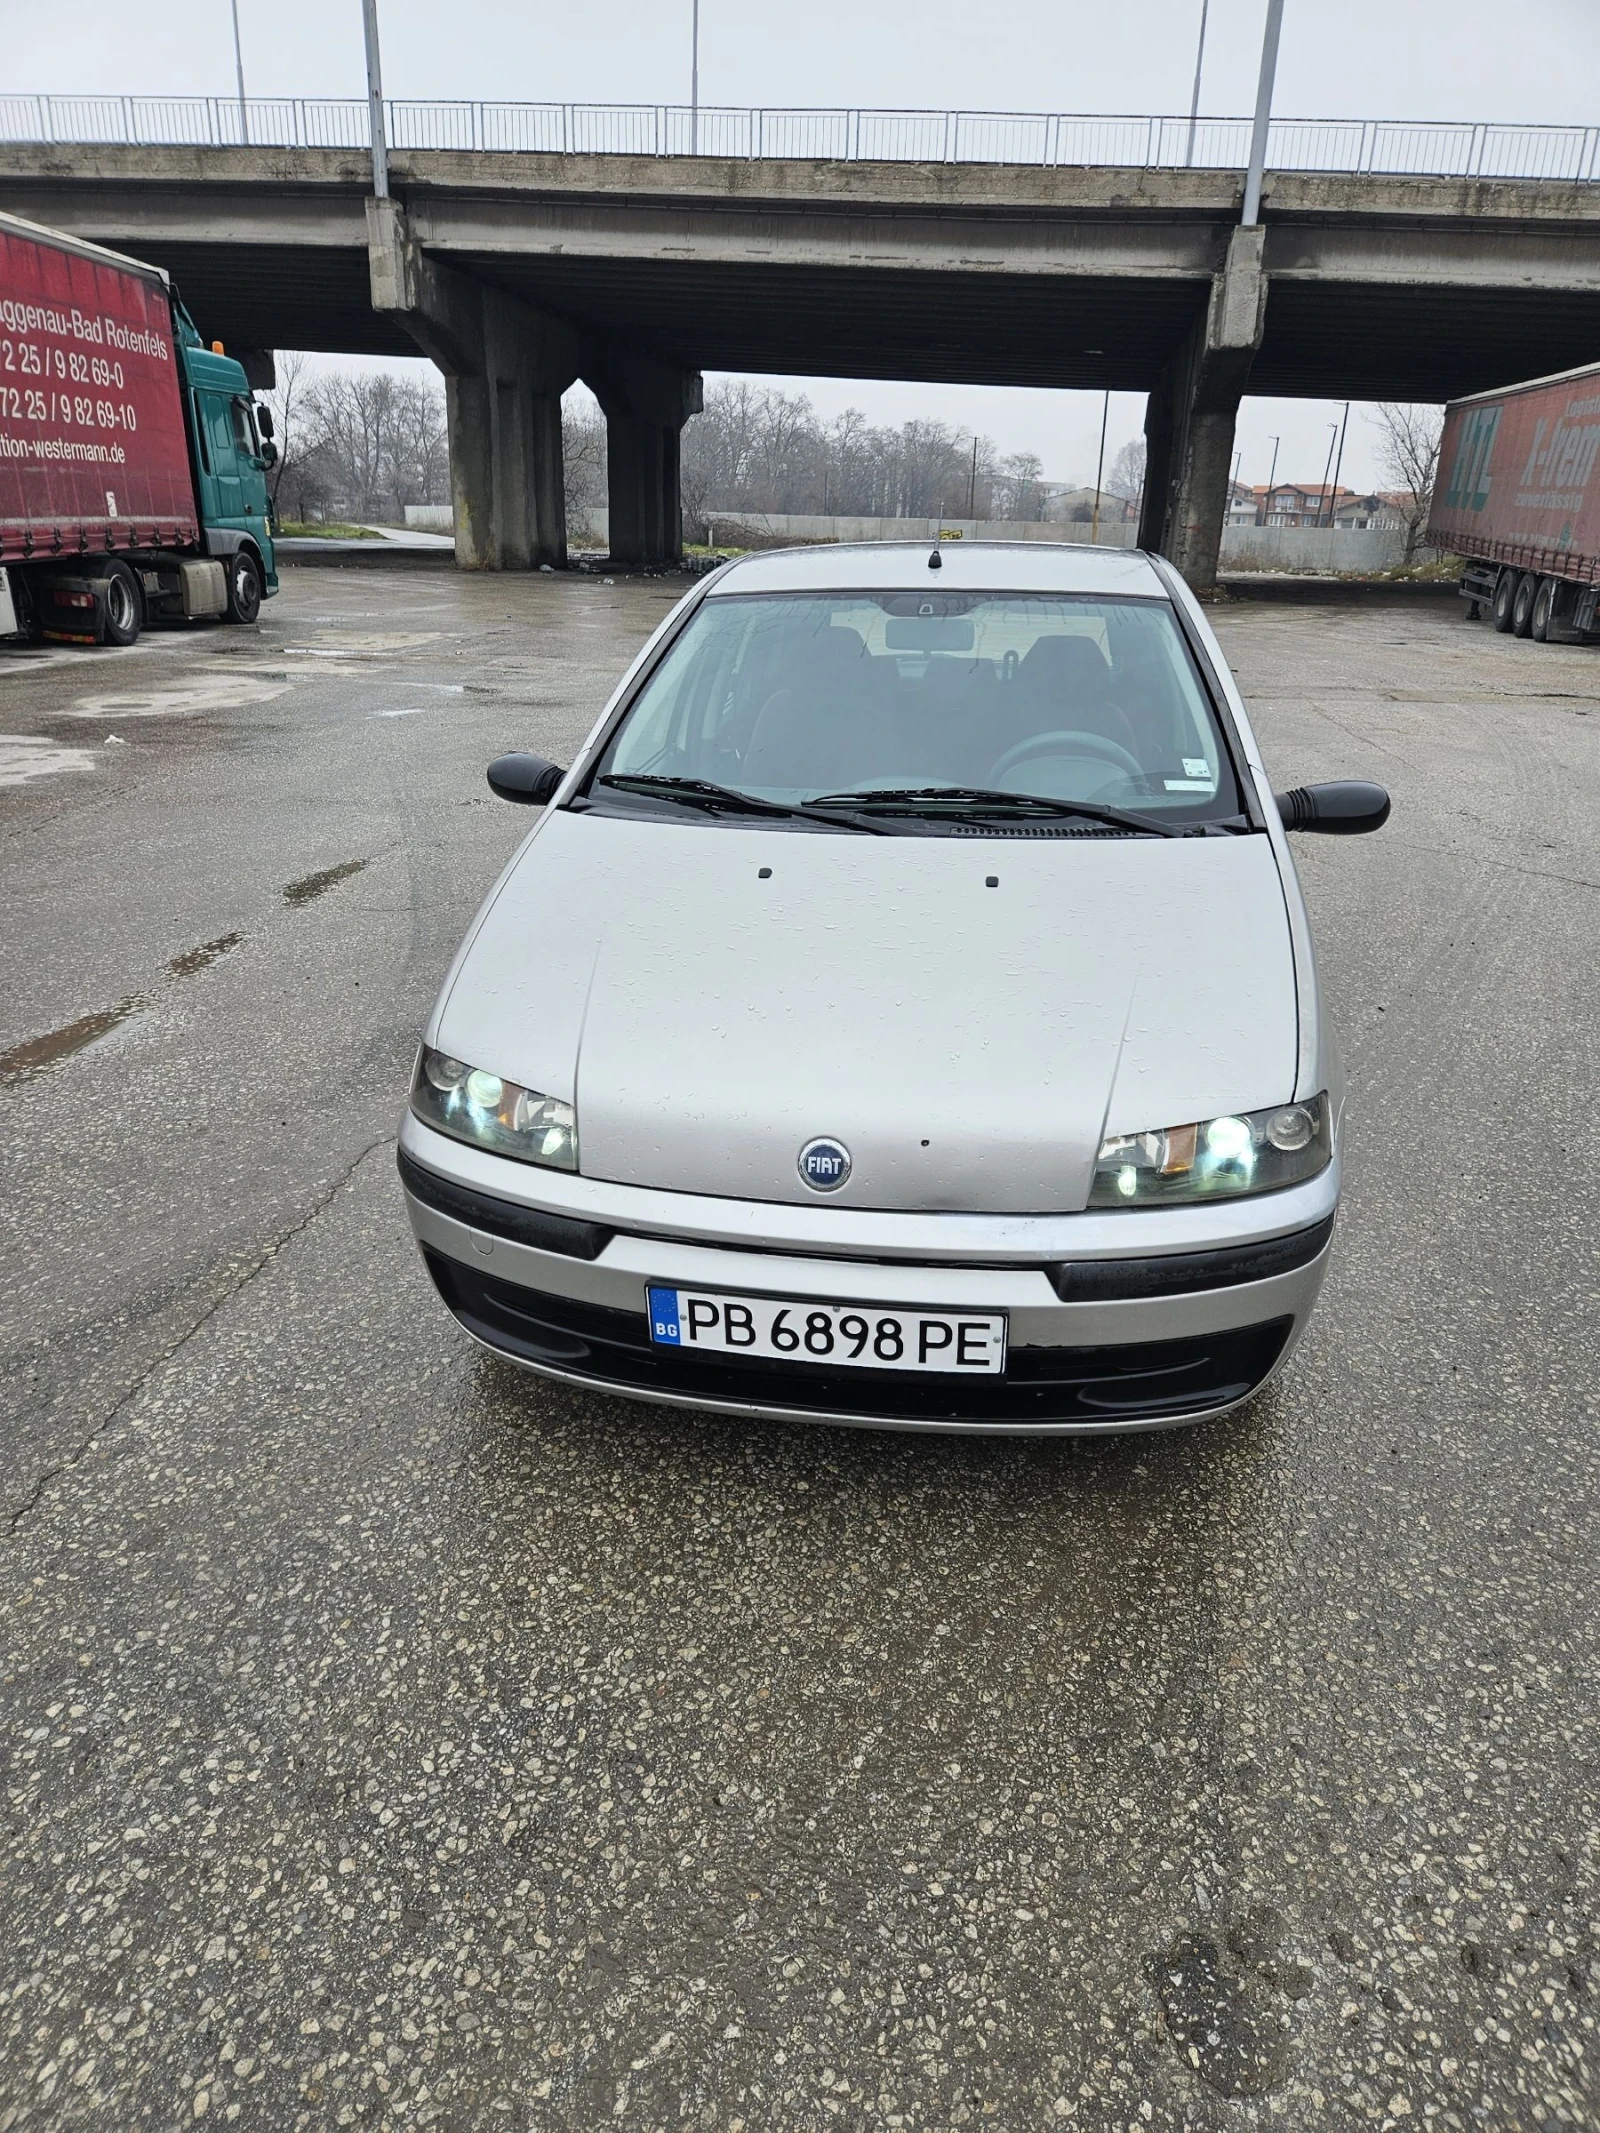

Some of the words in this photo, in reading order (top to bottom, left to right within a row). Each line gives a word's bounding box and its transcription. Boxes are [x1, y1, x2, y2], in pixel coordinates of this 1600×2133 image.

[104, 318, 168, 361] Rotenfels
[0, 339, 16, 371] 2
[18, 342, 41, 375] 25
[46, 346, 50, 377] /
[55, 349, 66, 379] 9
[69, 352, 90, 383] 82
[91, 357, 124, 390] 69-0
[25, 389, 47, 421] 25
[52, 392, 56, 422] /
[60, 394, 71, 424] 9
[74, 396, 95, 426] 82
[96, 400, 136, 431] 69-10
[0, 433, 125, 463] tion-westermann.de
[1446, 405, 1504, 511] HTL
[807, 1156, 842, 1174] FIAT
[656, 1322, 678, 1337] BG
[687, 1298, 757, 1347] PB
[770, 1309, 905, 1362] 6898
[917, 1320, 991, 1367] PE
